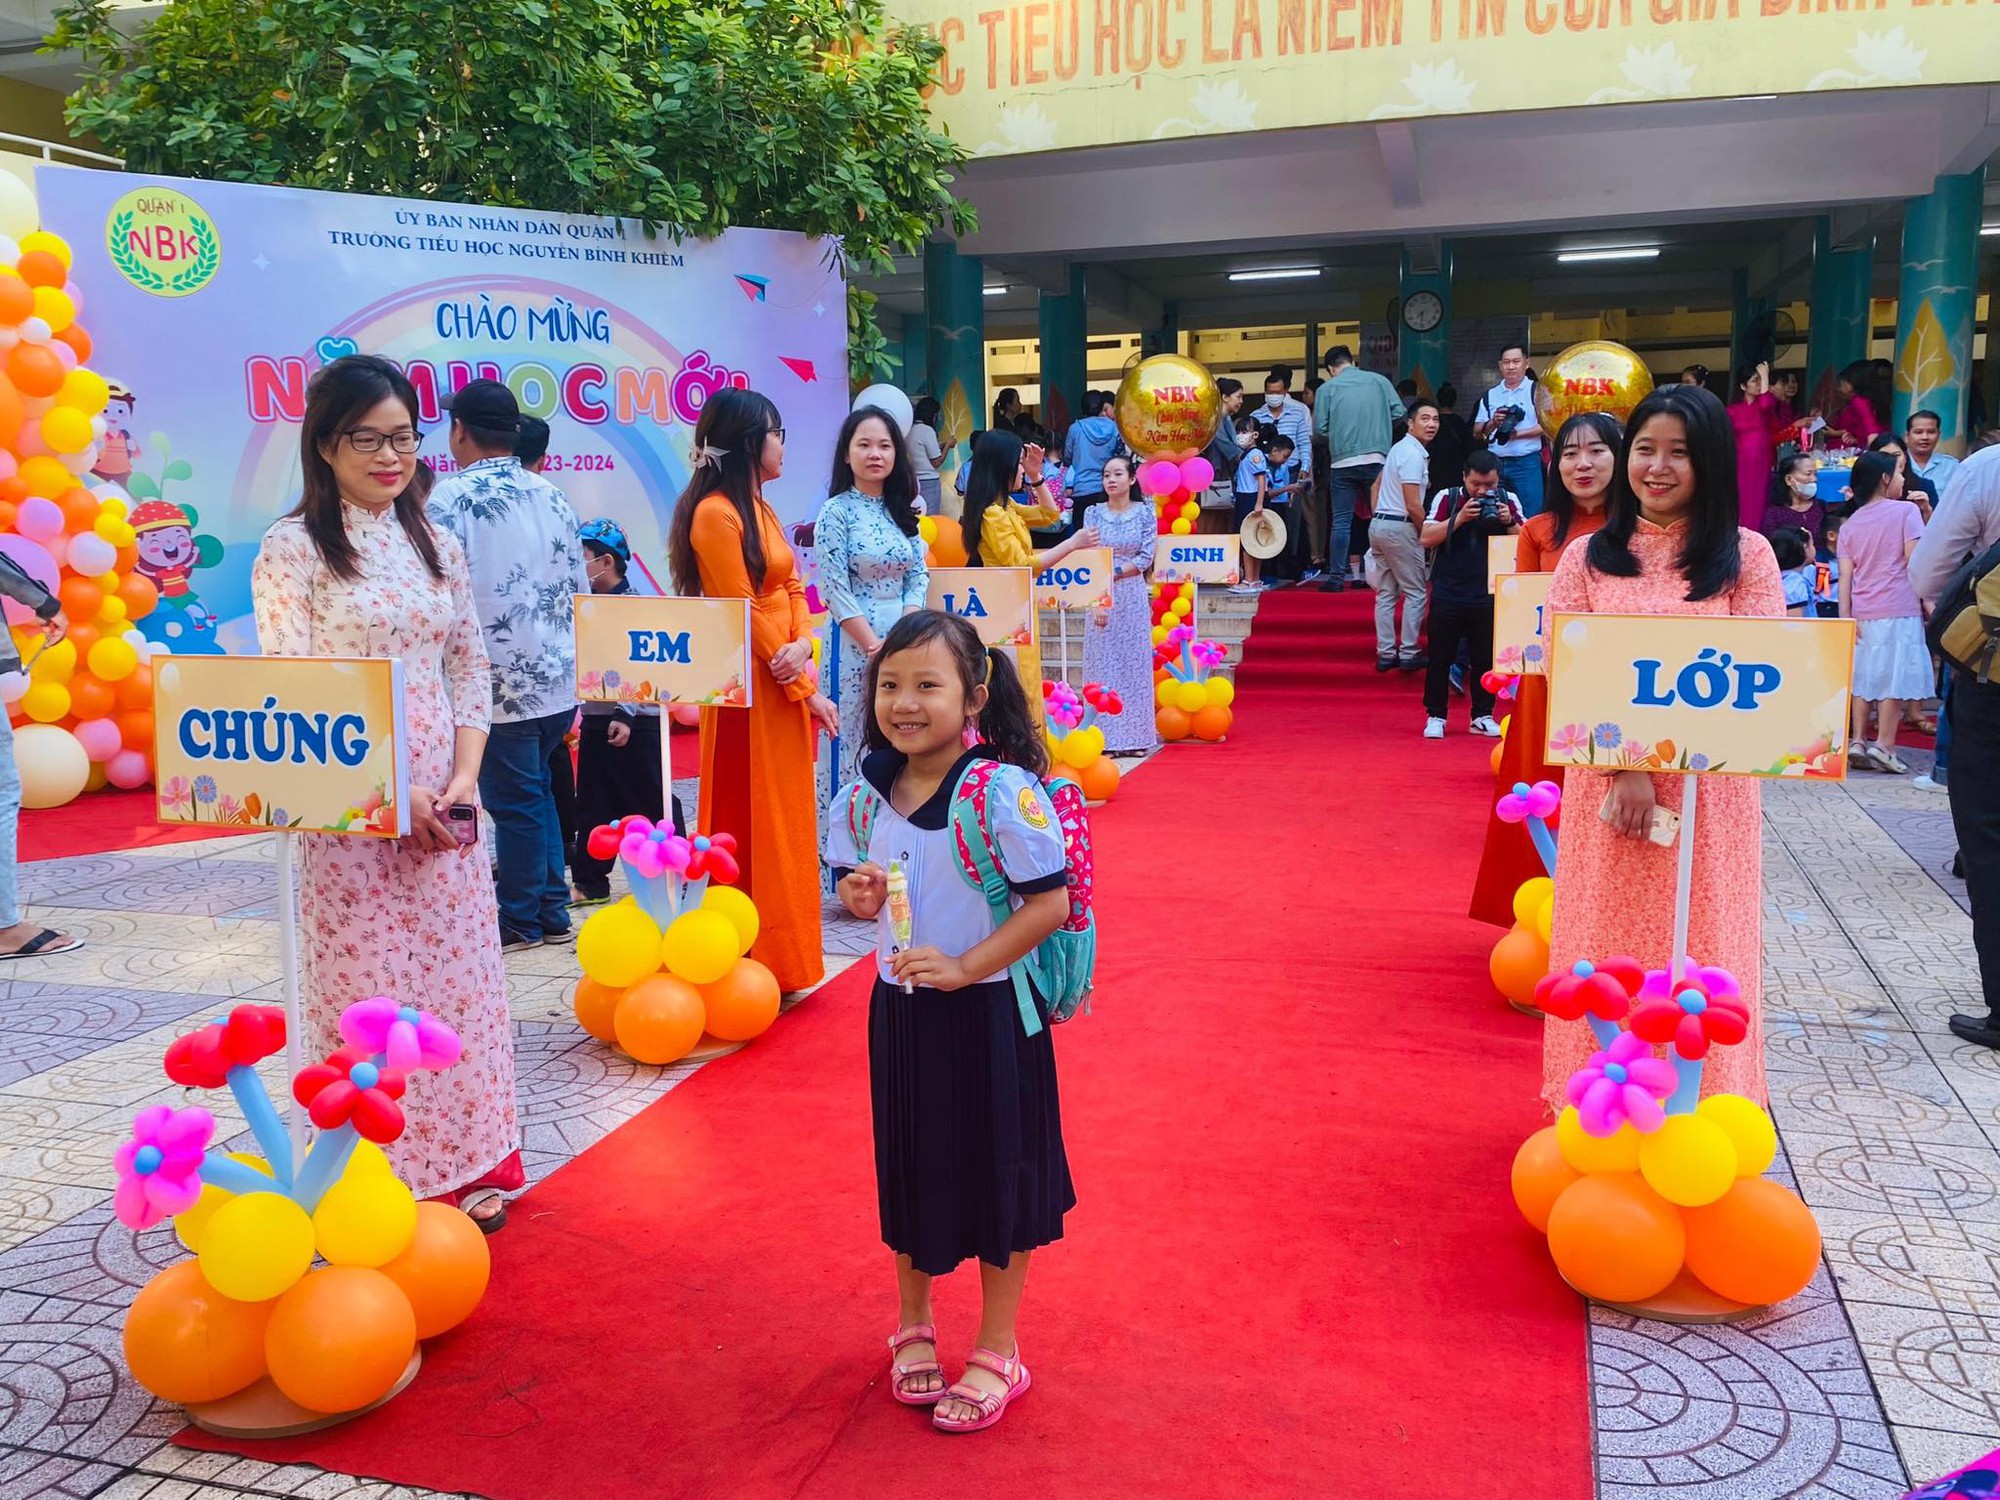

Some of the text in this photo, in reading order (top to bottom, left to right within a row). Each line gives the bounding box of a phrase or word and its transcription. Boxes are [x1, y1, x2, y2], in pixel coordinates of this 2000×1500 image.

[426, 213, 462, 229] BAN
[129, 225, 199, 261] NBK
[465, 241, 504, 257] HỌC
[436, 294, 610, 344] CHÀO MỪNG
[1153, 386, 1200, 406] NBK
[1564, 377, 1616, 397] NBK
[1170, 547, 1225, 563] SINH
[1036, 567, 1091, 590] HỌC
[942, 587, 988, 617] LÀ
[628, 630, 692, 664] EM
[1632, 647, 1782, 710] LỚP
[179, 696, 370, 767] CHÚNG
